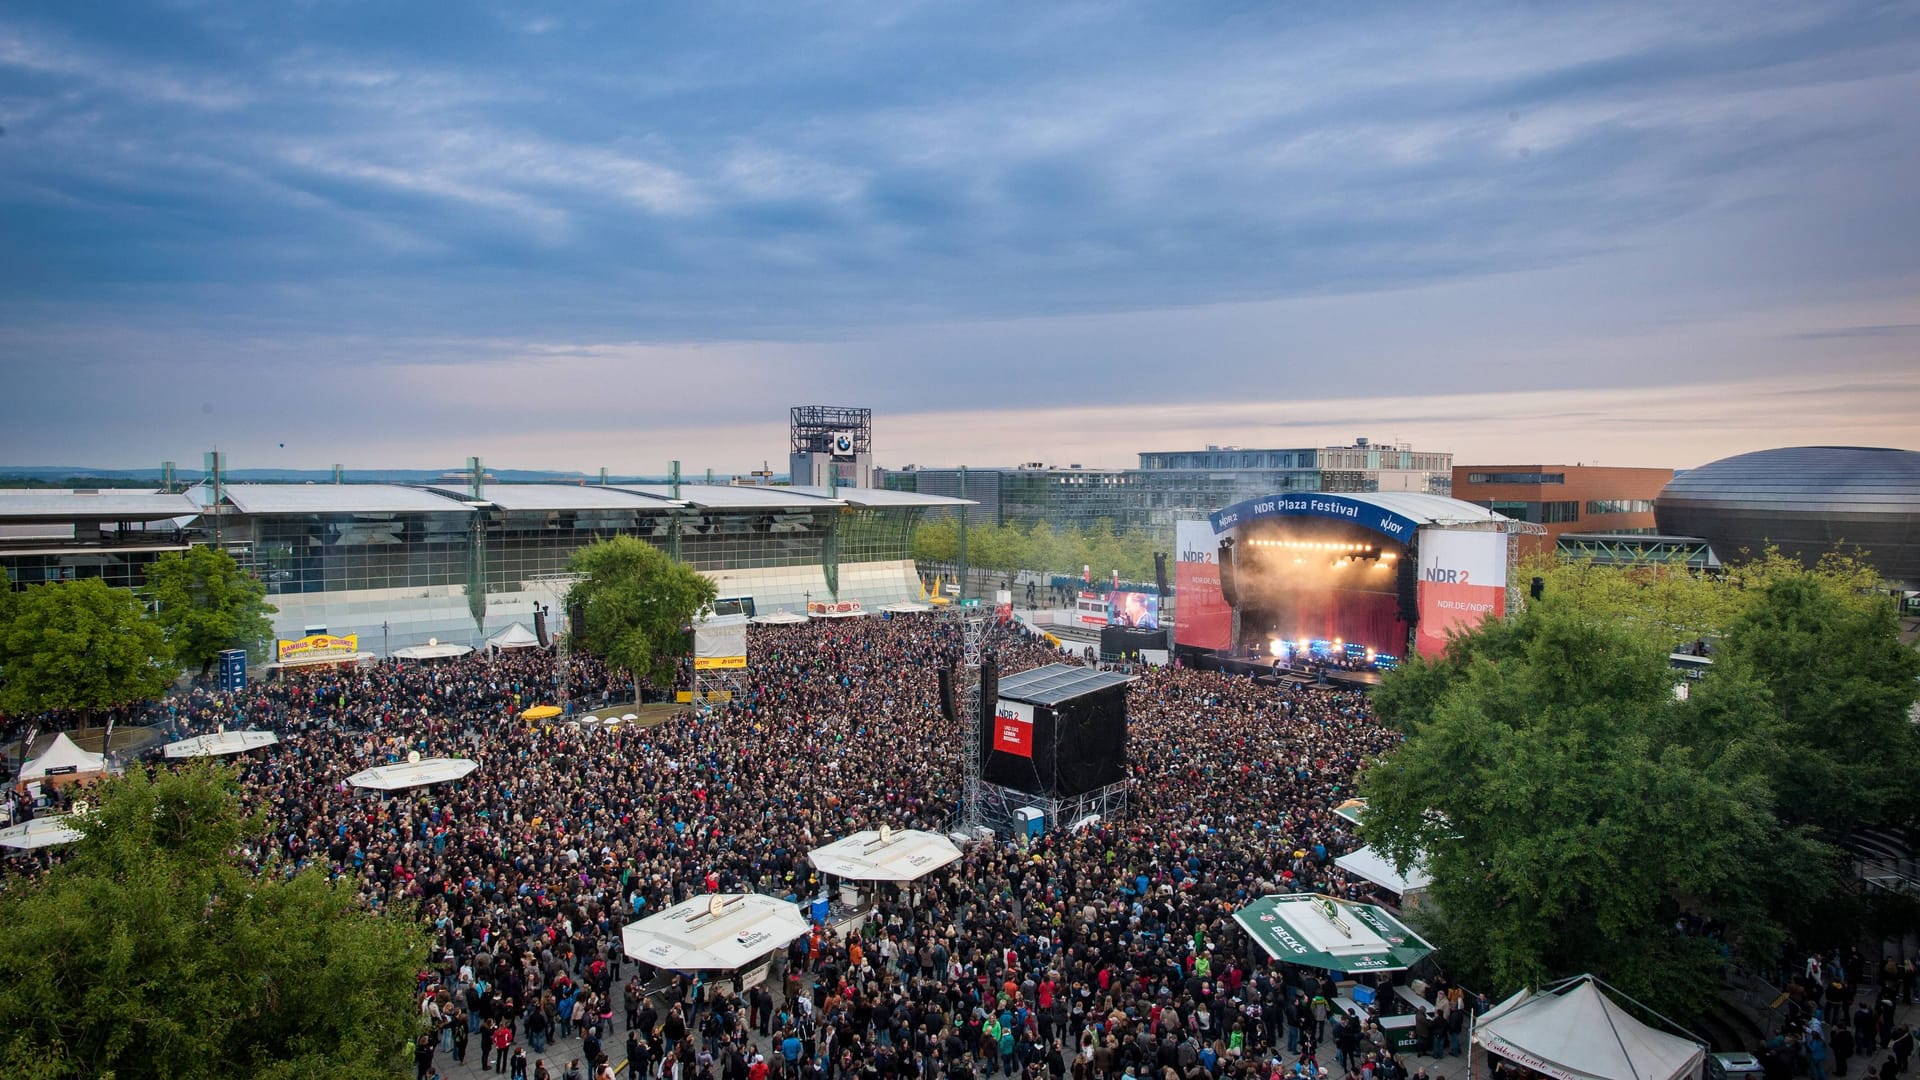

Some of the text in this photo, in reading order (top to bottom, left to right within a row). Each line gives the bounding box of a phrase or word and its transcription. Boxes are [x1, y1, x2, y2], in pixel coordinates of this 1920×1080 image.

[1254, 499, 1359, 518] NDR Plaza Festival
[1218, 512, 1238, 528] NDR 2
[1183, 550, 1212, 565] NDR 2
[1426, 567, 1470, 585] NDR 2
[999, 709, 1019, 720] NDR 2
[1271, 925, 1308, 954] BECK'S
